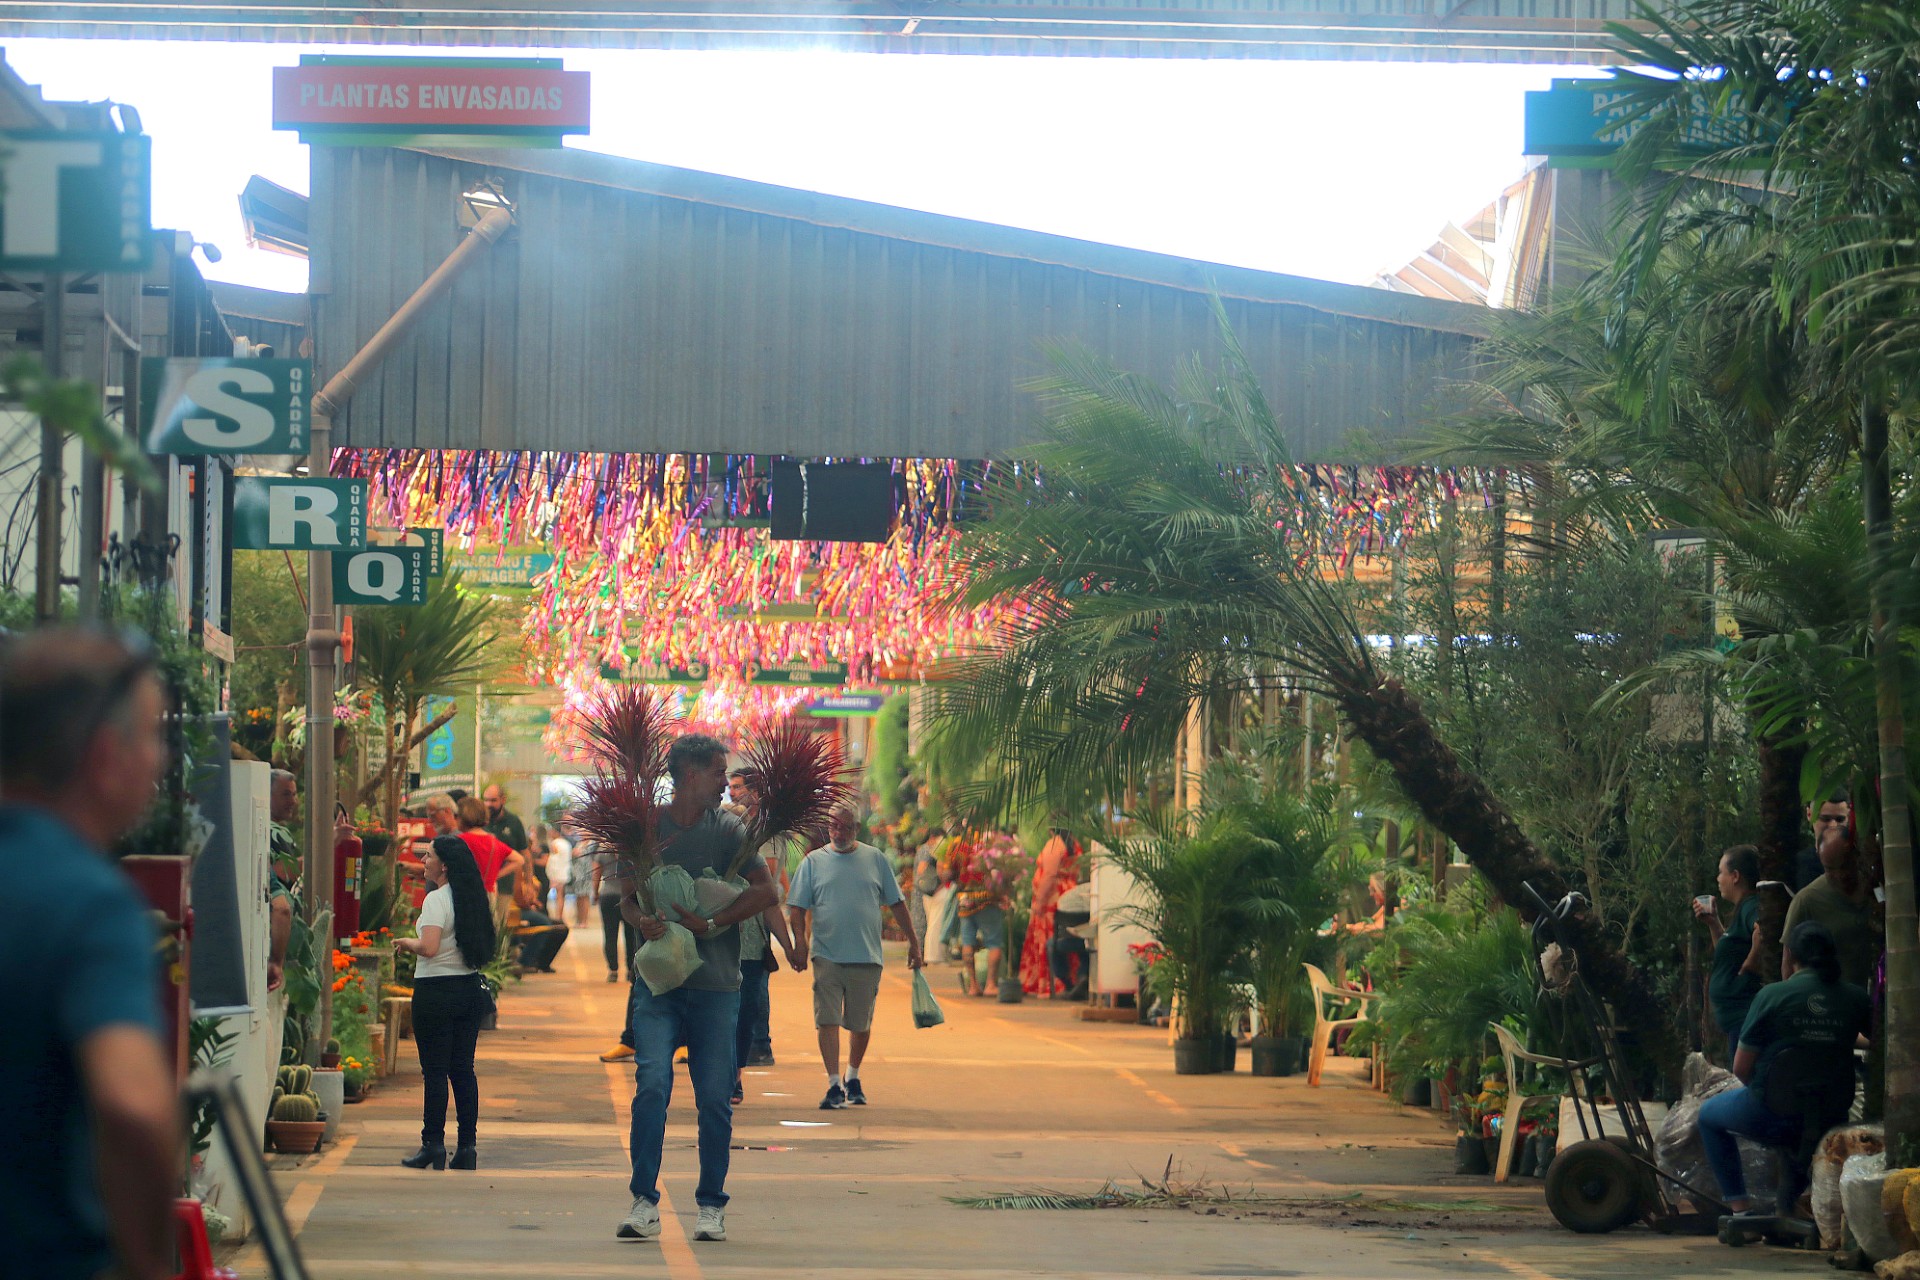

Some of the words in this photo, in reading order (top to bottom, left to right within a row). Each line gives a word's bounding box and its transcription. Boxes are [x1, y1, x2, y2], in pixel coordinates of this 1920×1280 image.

[301, 83, 409, 109] PLANTAS
[418, 84, 563, 111] ENVASADAS
[181, 366, 275, 448] S
[289, 367, 303, 450] QUADRA
[268, 485, 342, 546] R
[350, 484, 360, 548] QUADRA
[347, 551, 404, 602] Q
[412, 551, 421, 602] QUADRA
[1793, 1018, 1844, 1027] CHANTAL
